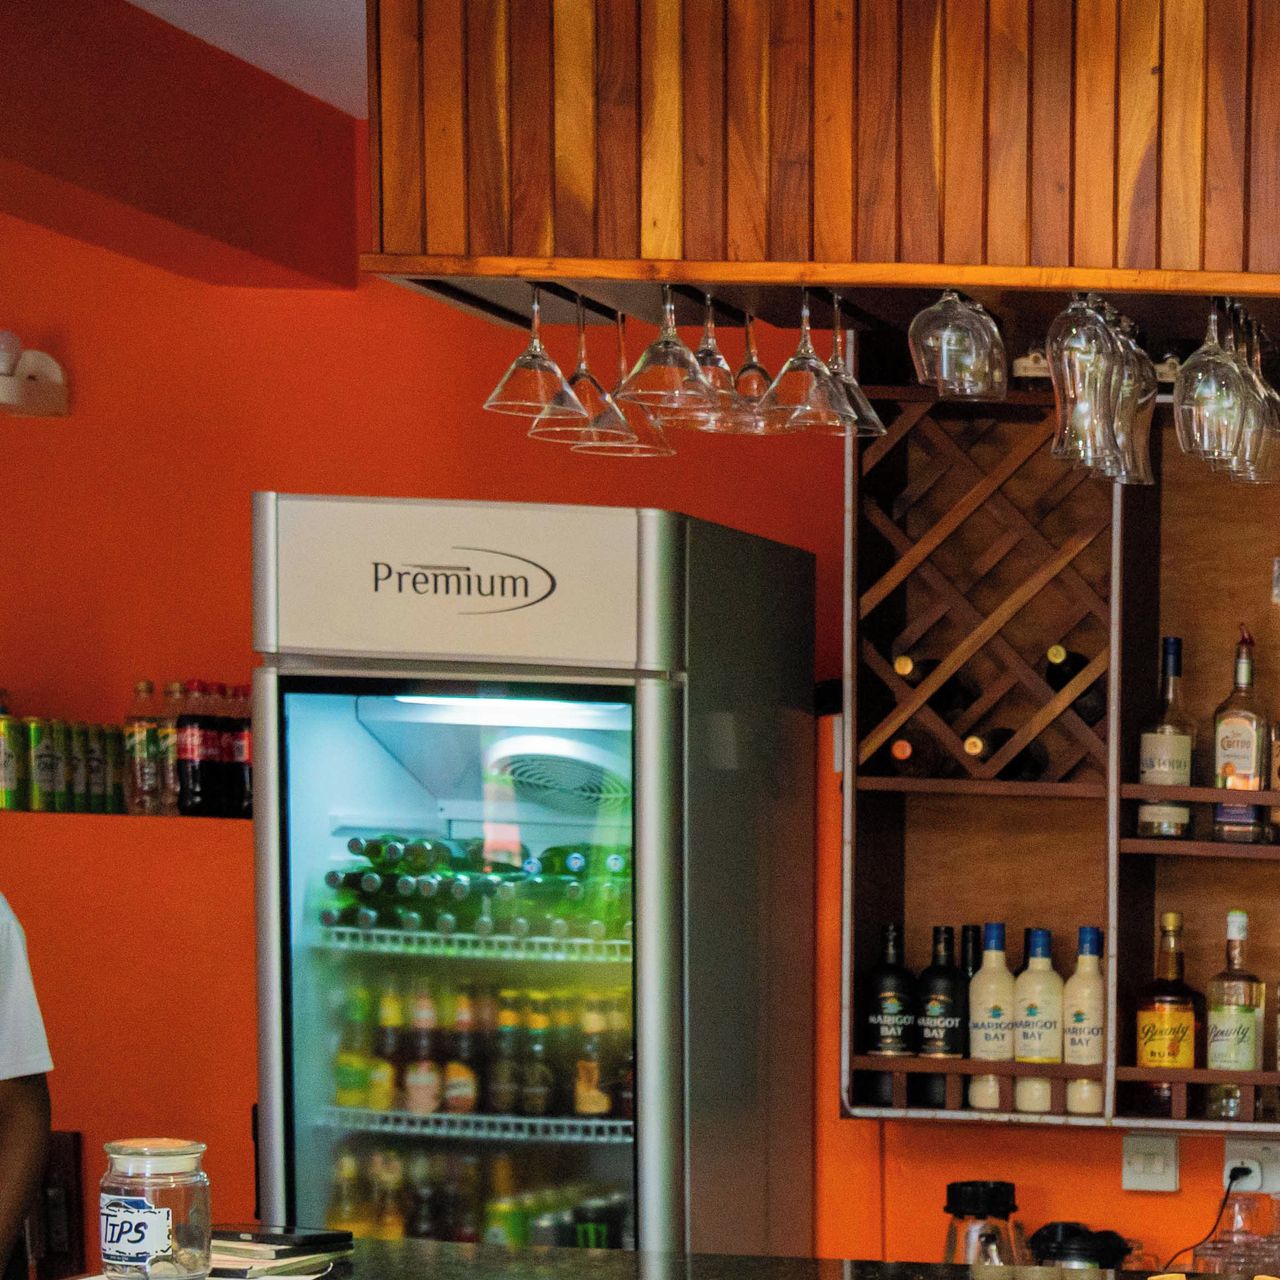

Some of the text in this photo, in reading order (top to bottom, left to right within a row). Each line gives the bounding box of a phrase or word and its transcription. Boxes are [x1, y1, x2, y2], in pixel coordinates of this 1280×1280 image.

[372, 561, 529, 599] Premium
[880, 1026, 903, 1037] BAY
[923, 1028, 946, 1039] BAY
[984, 1032, 1006, 1042] BAY
[1022, 1031, 1042, 1041] BAY
[1141, 1023, 1190, 1045] Bounty
[1209, 1024, 1250, 1044] Bounty
[1069, 1037, 1090, 1047] BAY
